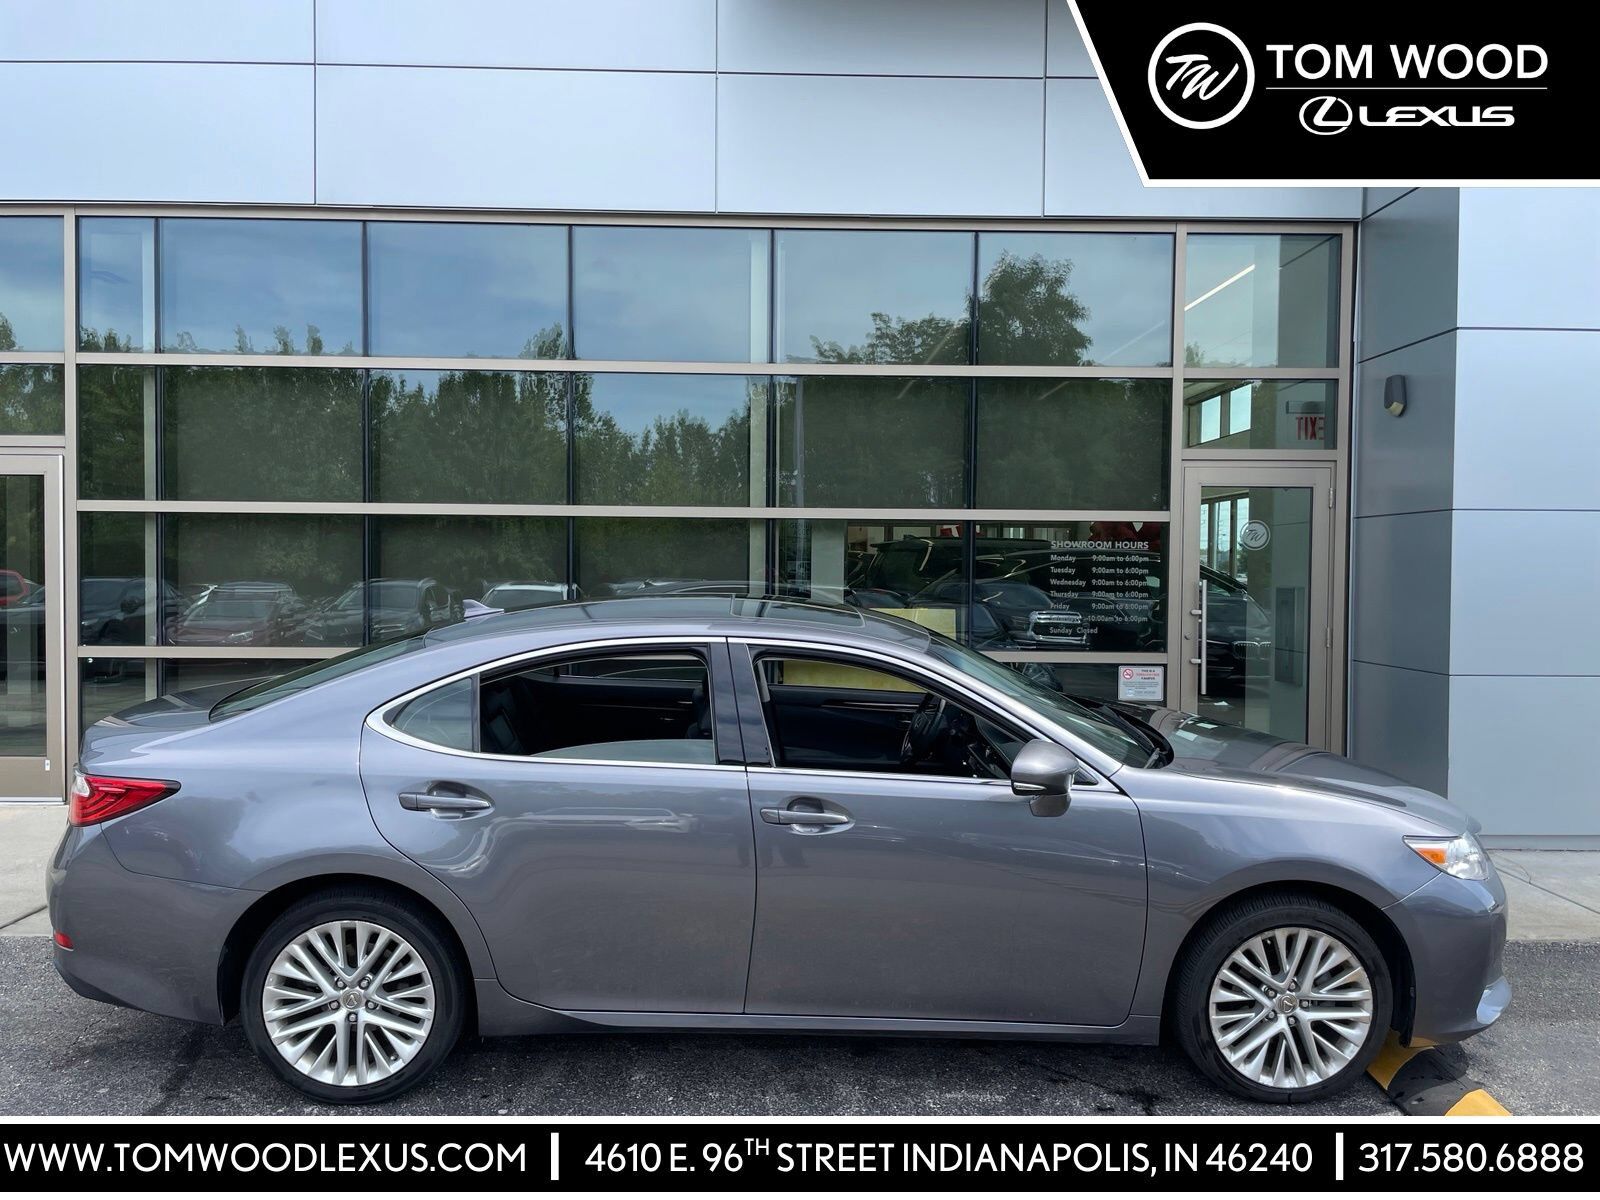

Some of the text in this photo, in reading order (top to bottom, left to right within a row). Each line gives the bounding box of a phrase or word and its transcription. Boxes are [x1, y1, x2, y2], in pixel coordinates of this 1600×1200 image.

[1051, 540, 1149, 549] SHOWROOM HOURS
[1125, 555, 1149, 563] 6:00pm
[1050, 567, 1075, 575] Tuesday
[1125, 567, 1149, 575] 6:00pm
[1050, 579, 1086, 587] Wednesday
[1125, 579, 1149, 587] 6:00pm
[1125, 591, 1149, 599] 6:00pm
[1051, 603, 1070, 611] Friday
